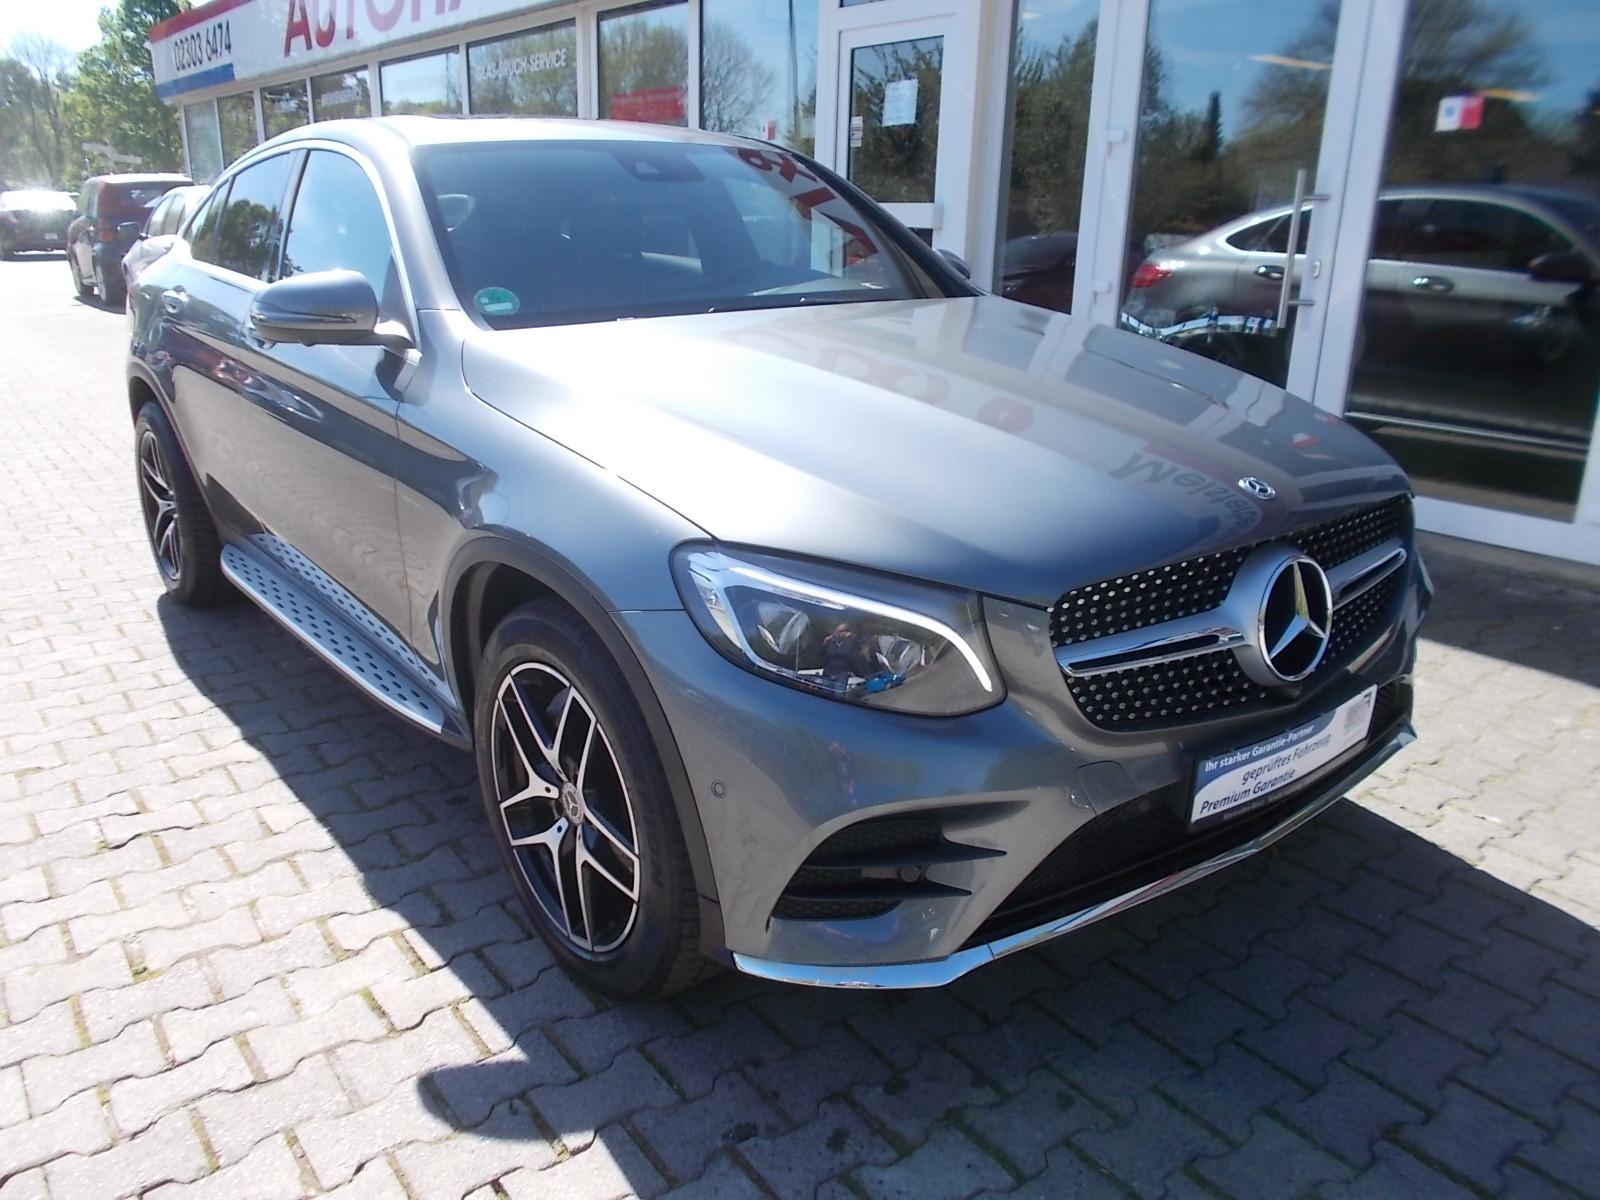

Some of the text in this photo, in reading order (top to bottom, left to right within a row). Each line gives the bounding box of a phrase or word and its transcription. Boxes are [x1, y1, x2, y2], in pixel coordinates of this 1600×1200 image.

[173, 20, 232, 71] 02303 6474
[1205, 724, 1315, 772] Ihr starker Garantie-Partner
[1241, 752, 1292, 786] geprüftes
[1200, 787, 1251, 815] Premium
[1252, 768, 1296, 797] Garantie
